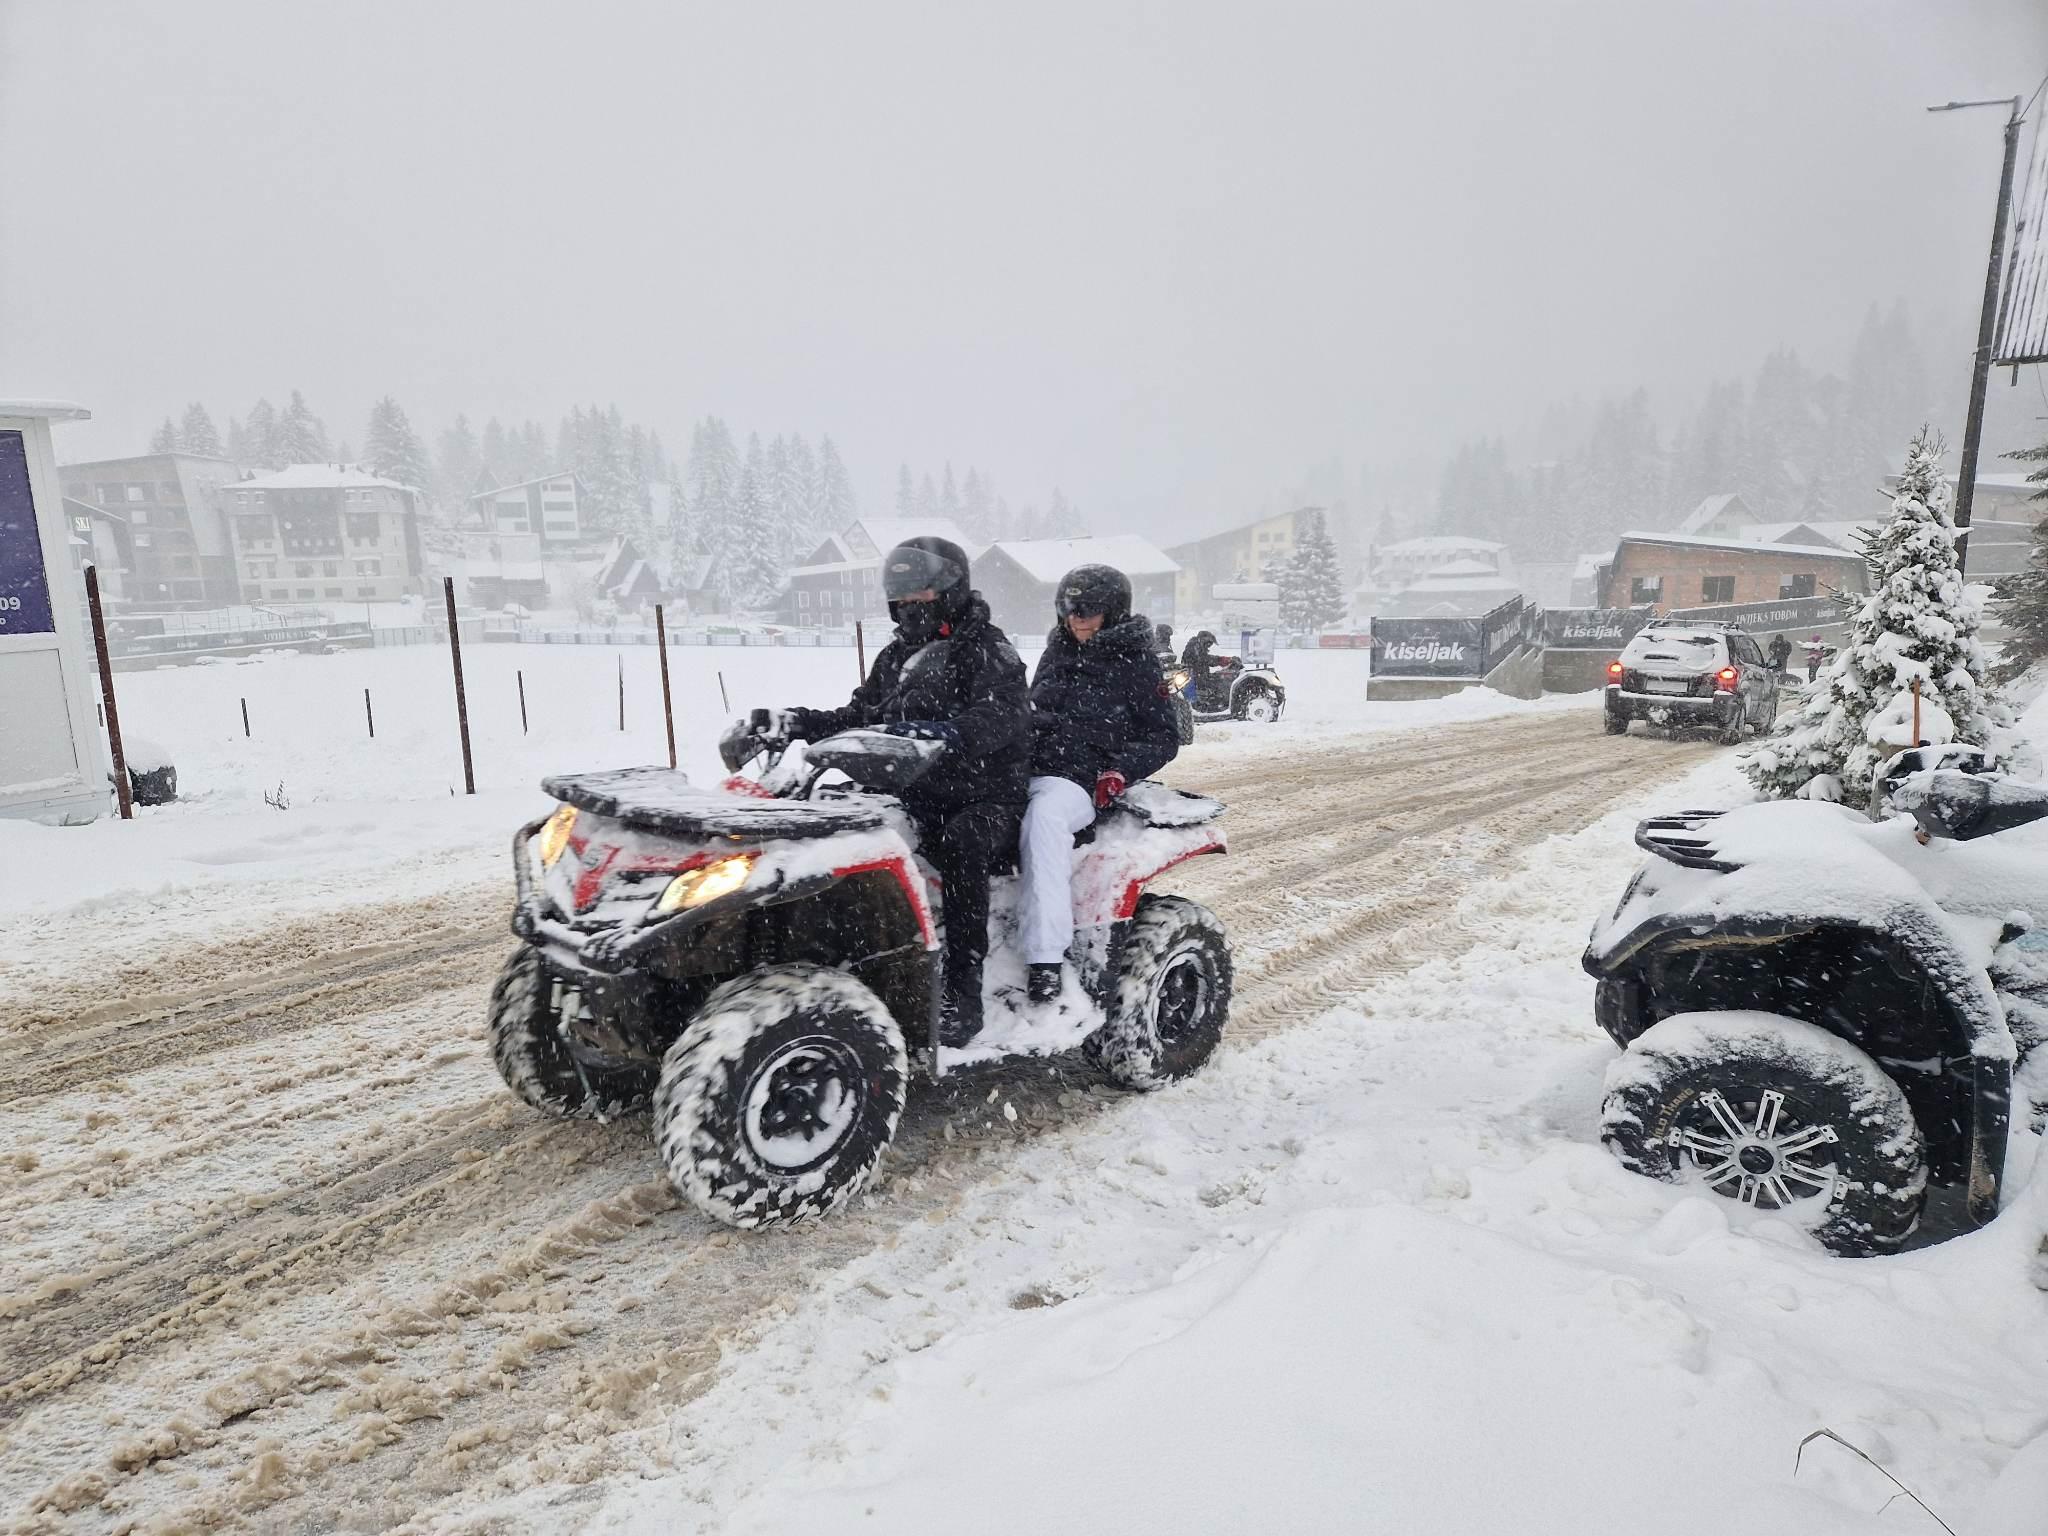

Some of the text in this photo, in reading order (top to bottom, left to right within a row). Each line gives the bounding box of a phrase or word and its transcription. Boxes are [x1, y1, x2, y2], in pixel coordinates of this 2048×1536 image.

[75, 516, 90, 529] SKI
[1769, 609, 1798, 622] TOBOM
[1563, 625, 1624, 640] kiseljak
[1384, 641, 1466, 663] kiseljak
